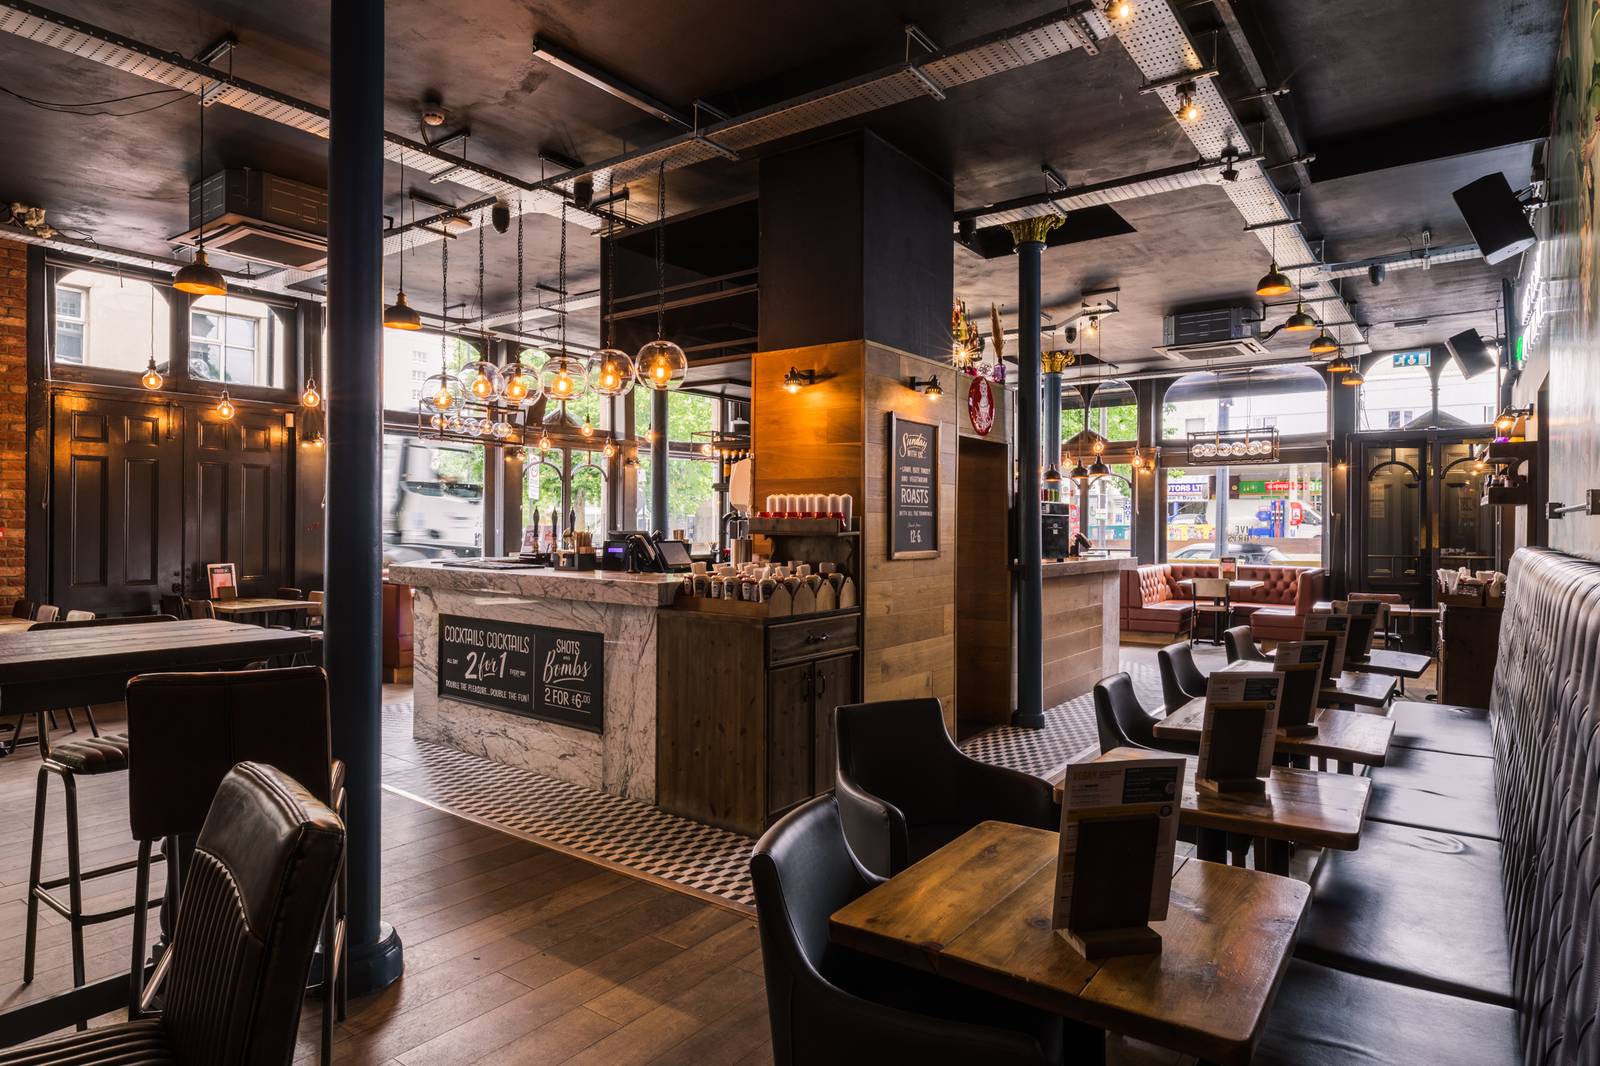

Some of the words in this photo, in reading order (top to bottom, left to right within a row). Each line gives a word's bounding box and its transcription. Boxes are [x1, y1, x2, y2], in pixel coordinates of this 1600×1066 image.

[899, 432, 928, 458] Sunday
[901, 488, 929, 504] ROASTS
[444, 625, 484, 647] COCKTAILS
[486, 631, 530, 654] COCKTAILS
[556, 638, 580, 655] SHOTS
[464, 651, 478, 679] 2
[478, 651, 498, 681] for
[499, 651, 507, 679] 1
[543, 649, 592, 683] Bombs
[445, 679, 460, 689] DOUBLE
[460, 682, 468, 691] THE
[508, 692, 517, 701] THE
[544, 687, 551, 702] 2
[552, 689, 569, 706] FOR
